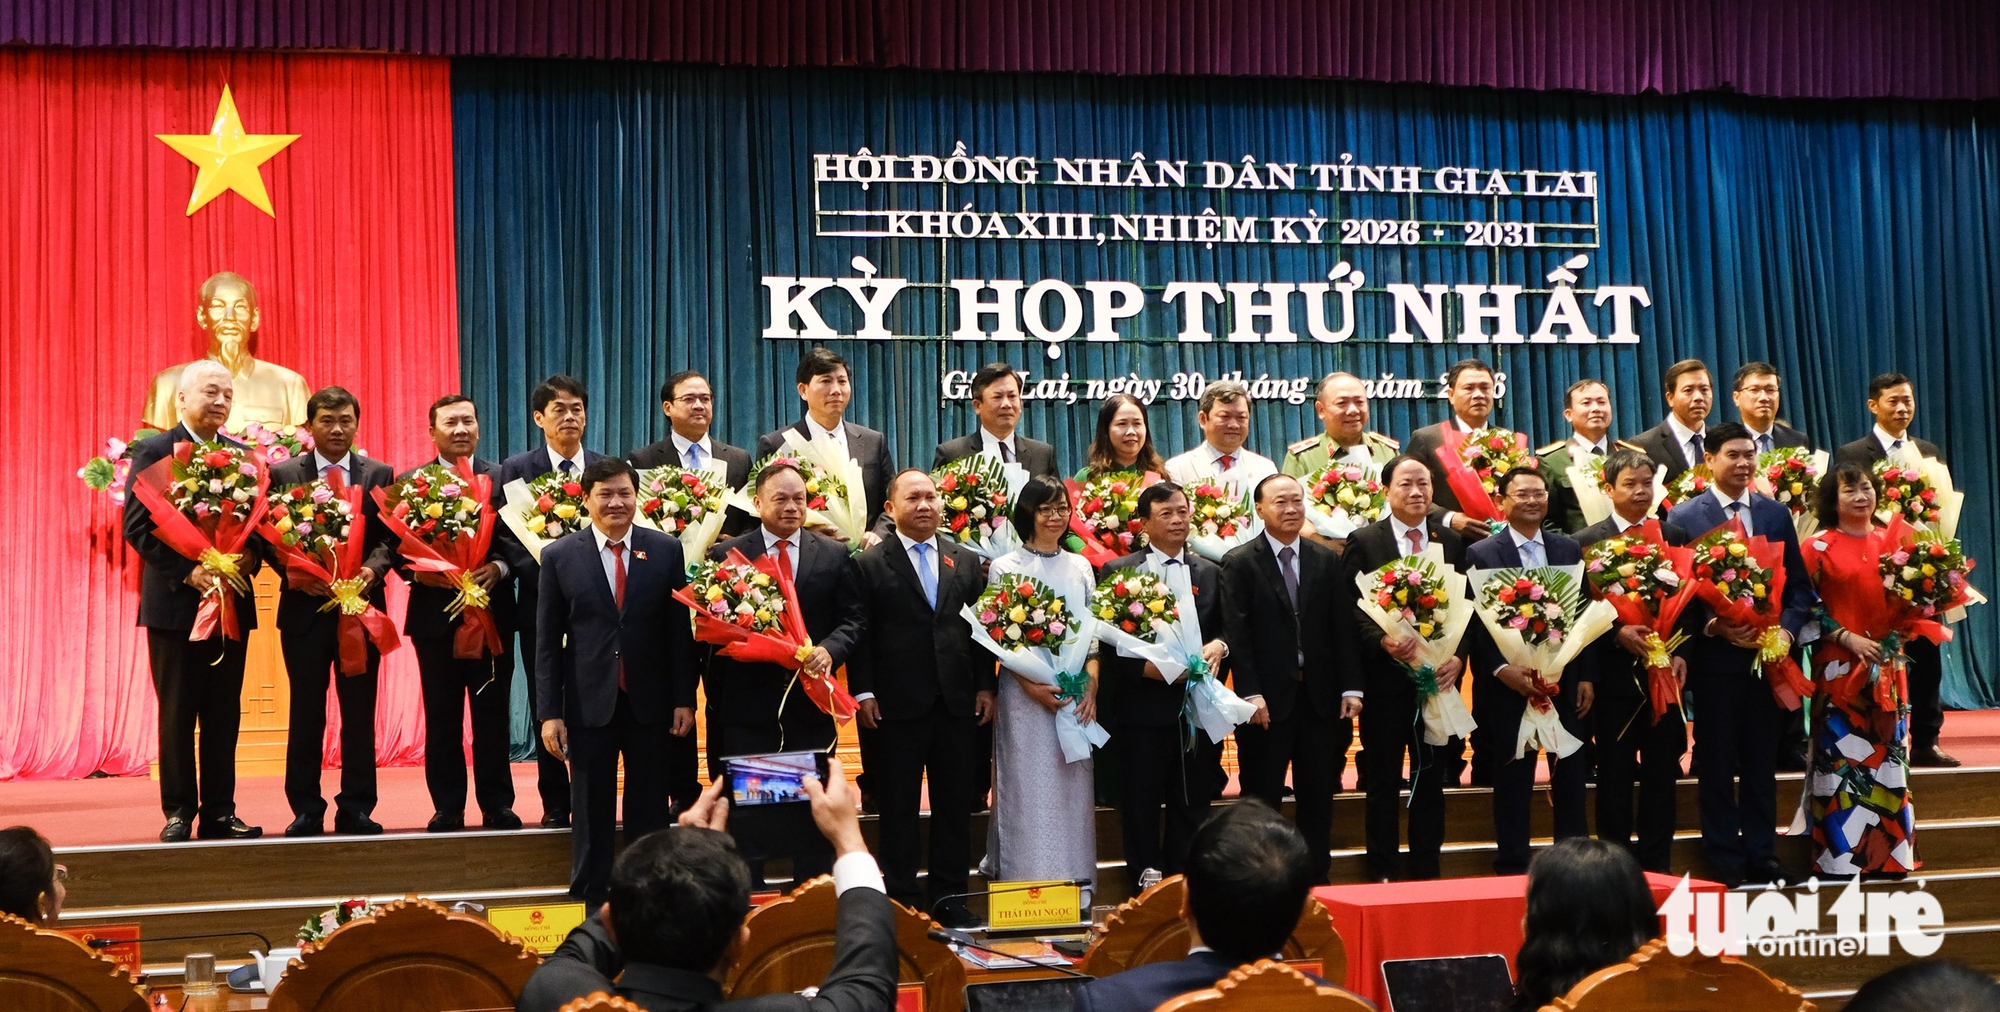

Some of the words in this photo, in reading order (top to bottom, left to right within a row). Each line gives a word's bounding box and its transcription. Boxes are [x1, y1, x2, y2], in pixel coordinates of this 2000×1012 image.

[813, 147, 898, 191] HỘI
[909, 140, 1039, 185] ĐỒNG
[1053, 152, 1188, 188] NHÂN
[1202, 154, 1298, 191] DÂN
[1310, 153, 1423, 193] TỈNH
[1434, 166, 1512, 195] GIA
[1523, 169, 1597, 197] LAI
[888, 203, 1012, 238] KHÓA
[1111, 207, 1259, 250] NHIỆM
[1270, 208, 1327, 244] KỲ
[1340, 218, 1420, 245] 2026
[1464, 221, 1538, 247] 2031
[761, 255, 907, 340] KỲ
[950, 278, 1145, 360] HỌP
[1162, 261, 1365, 343] THỨ
[1386, 254, 1652, 344] NHẤT
[942, 370, 978, 400] Gi
[1019, 371, 1077, 405] Lai,
[1085, 371, 1162, 406] ngày
[1169, 371, 1206, 400] 30
[1363, 372, 1424, 399] năm
[1437, 372, 1507, 400] 26
[998, 908, 1022, 919] THÁI
[1024, 909, 1042, 919] ĐẠI
[1044, 907, 1073, 918] NGỌC
[524, 935, 552, 945] NGỌC
